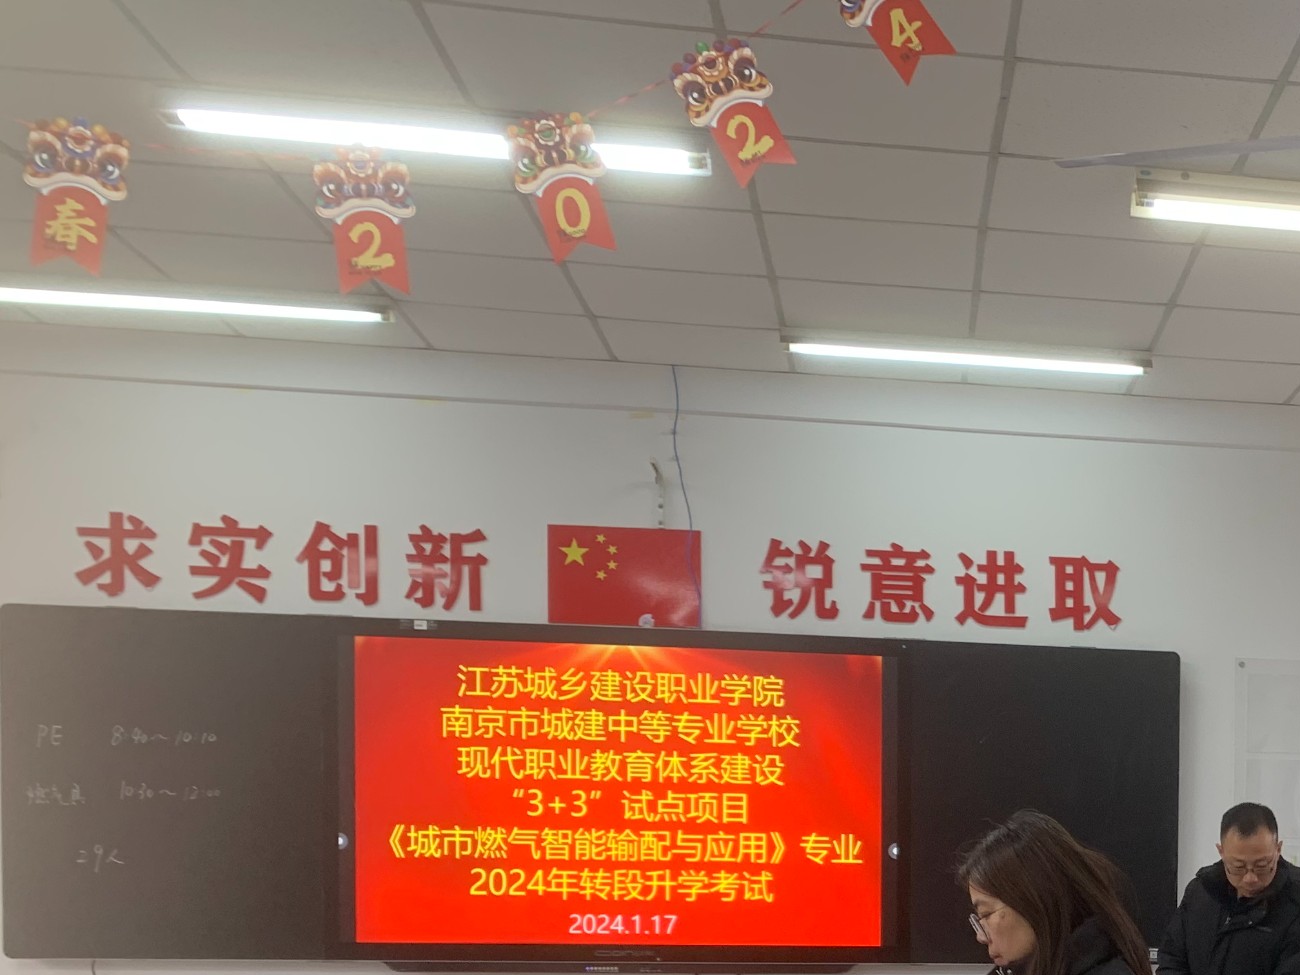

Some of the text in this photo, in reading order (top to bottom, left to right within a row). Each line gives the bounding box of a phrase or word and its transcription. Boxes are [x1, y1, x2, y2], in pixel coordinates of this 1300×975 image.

[45, 197, 98, 251] 春
[75, 512, 1122, 631] 求实创新 锐意进取
[456, 664, 785, 708] 江苏城乡建设职业学院
[440, 704, 801, 748] 南京市城建中等专业学校
[457, 745, 785, 786] 现代职业教育体系建设
[469, 867, 774, 903] 2024年转段升学考试
[568, 913, 677, 935] 2024.1.17
